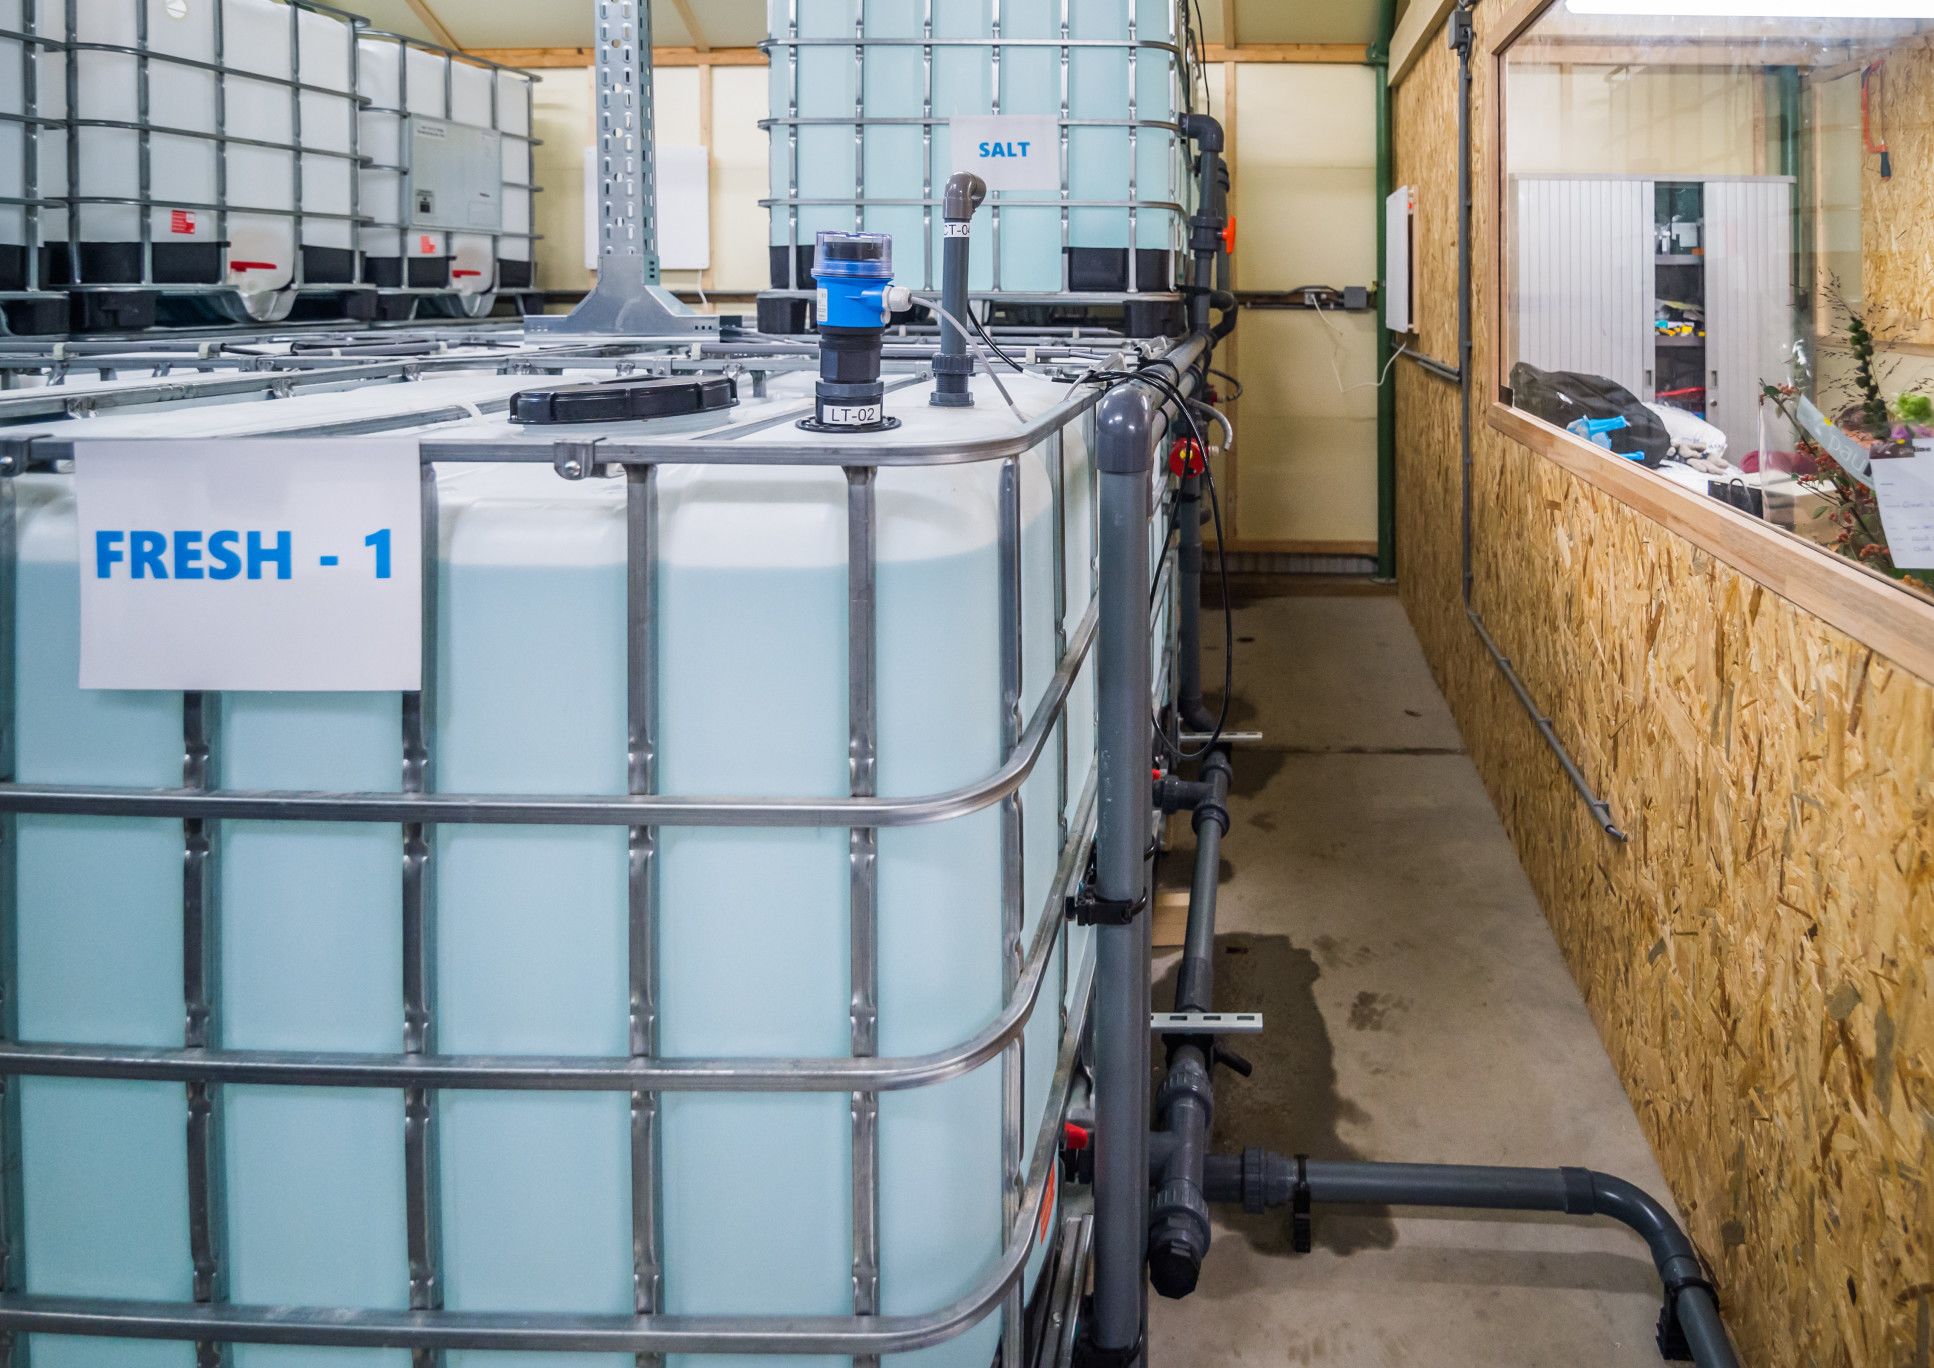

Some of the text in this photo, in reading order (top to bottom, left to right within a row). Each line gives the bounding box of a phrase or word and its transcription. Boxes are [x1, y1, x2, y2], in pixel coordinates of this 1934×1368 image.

[979, 142, 1030, 157] SALT
[831, 407, 875, 422] LT-02
[95, 528, 393, 581] FRESH - 1
